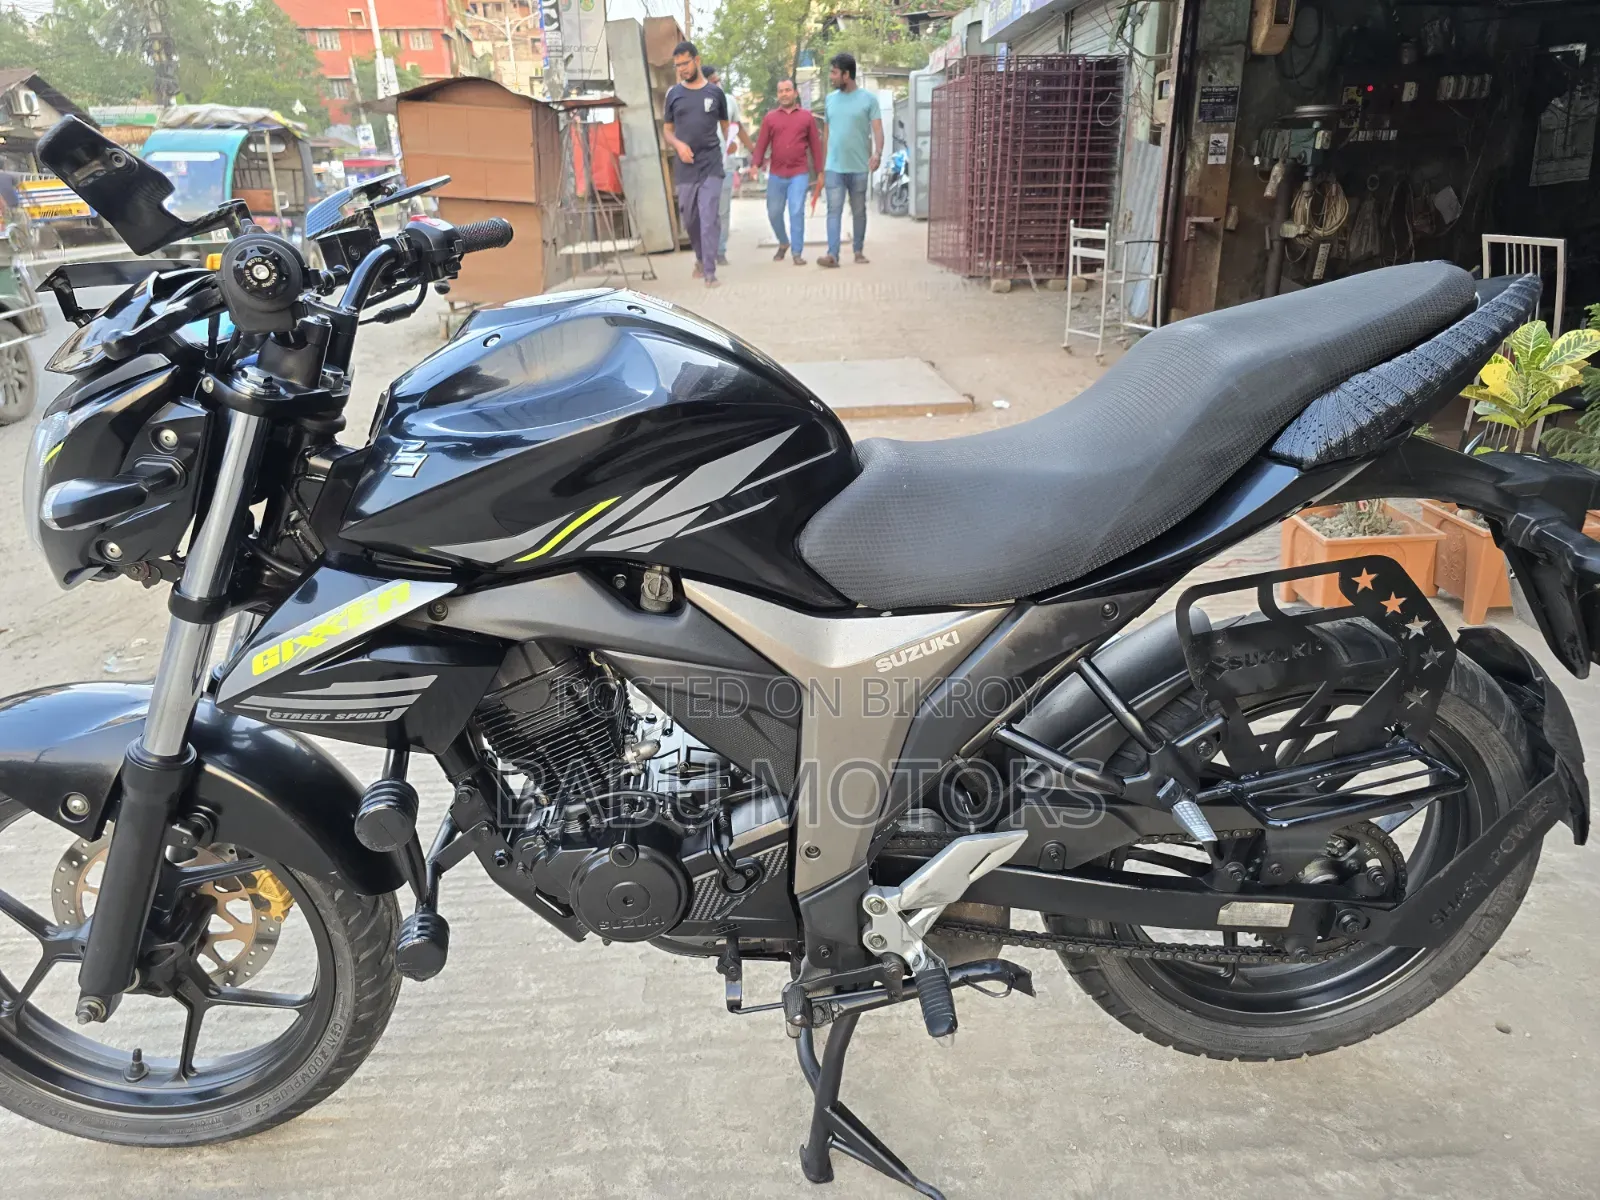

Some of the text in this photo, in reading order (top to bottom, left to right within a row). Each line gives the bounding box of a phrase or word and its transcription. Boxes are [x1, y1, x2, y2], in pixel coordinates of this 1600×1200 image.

[252, 581, 411, 676] GIXXER
[875, 630, 961, 673] SUZUKI
[271, 711, 390, 721] STREET SPORT
